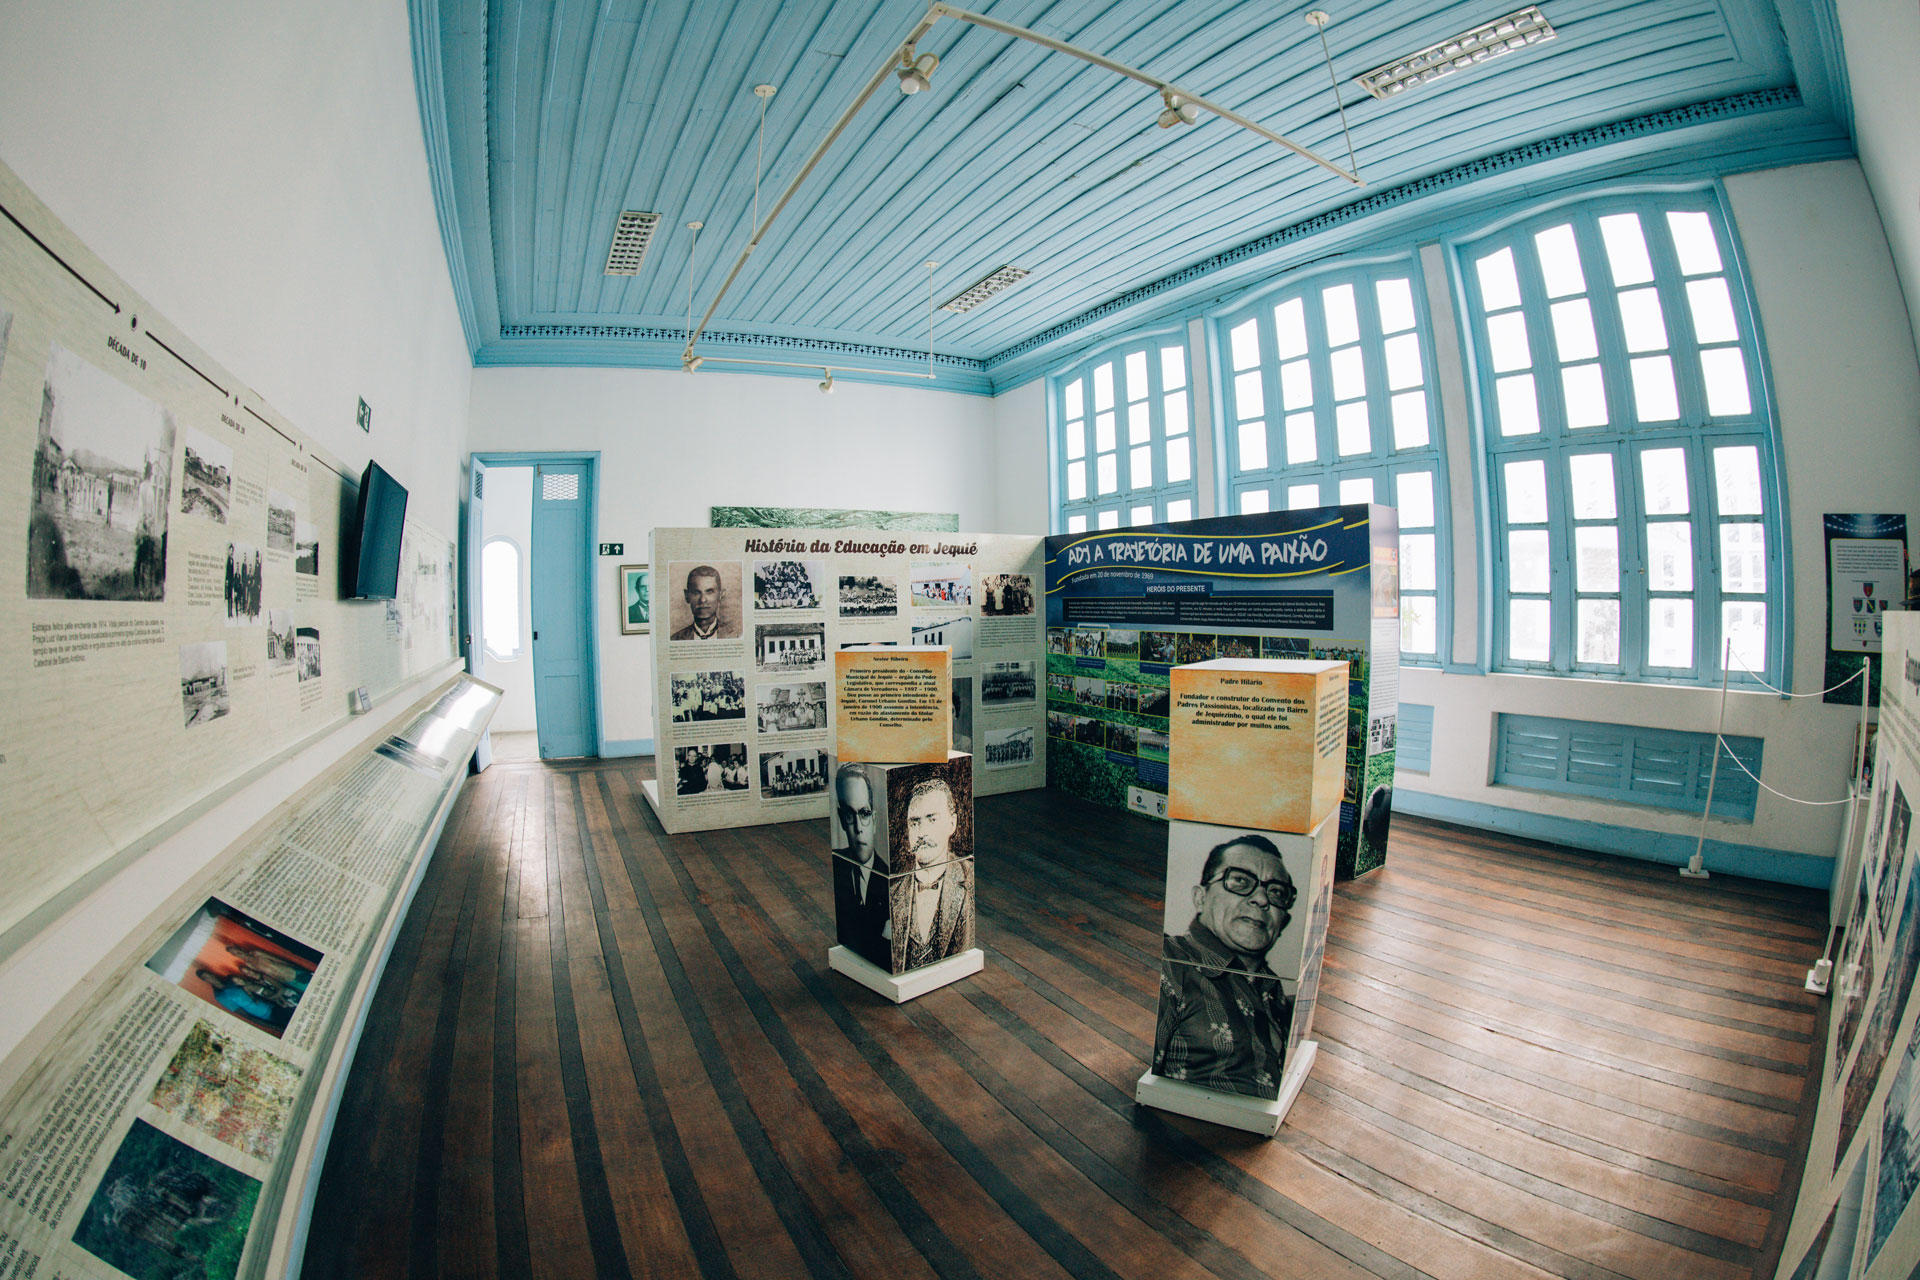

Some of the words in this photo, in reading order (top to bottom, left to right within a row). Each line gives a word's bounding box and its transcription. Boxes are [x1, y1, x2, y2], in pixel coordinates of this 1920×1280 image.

[108, 336, 130, 360] DÉCADA
[131, 353, 139, 364] DE
[140, 358, 146, 370] 10
[236, 423, 241, 432] DE
[745, 539, 807, 553] História
[810, 540, 831, 553] da
[835, 540, 906, 557] Educação
[910, 543, 930, 554] em
[933, 542, 978, 557] Jequié
[1068, 547, 1091, 565] ADJ
[1094, 544, 1104, 562] A
[1108, 538, 1187, 565] TRAJETÓRIA
[1194, 542, 1213, 565] DE
[1219, 542, 1255, 564] UMA
[1261, 534, 1328, 565] PAIXÃO
[1072, 573, 1089, 584] Fundada
[1110, 571, 1133, 579] novembro
[1141, 572, 1153, 580] 1969
[1147, 584, 1166, 593] HERÓIS
[1200, 702, 1240, 711] Passionistas,
[1205, 711, 1244, 720] Jequiezinho,
[6, 1158, 21, 1182] entanto,
[28, 1127, 42, 1148] indícios
[42, 1114, 51, 1126] mais
[52, 1094, 65, 1113] antigos
[64, 1086, 71, 1095] de
[18, 1198, 25, 1207] se
[24, 1170, 42, 1197] encontra
[44, 1144, 56, 1162] Pedra
[56, 1135, 63, 1144] da
[75, 1085, 95, 1116] Monumento
[46, 1164, 59, 1183] Dizem
[62, 1124, 84, 1157] historiadores
[8, 1176, 24, 1199] Manoel
[22, 1154, 38, 1177] Vitorino,
[39, 1208, 49, 1221] que
[45, 1188, 60, 1209] viviam
[57, 1179, 64, 1188] na
[77, 1124, 96, 1154] Localizada
[49, 1219, 56, 1228] de
[53, 1191, 72, 1219] conhecer
[69, 1180, 77, 1192] um
[74, 1154, 92, 1181] ambiente
[89, 1126, 108, 1154] doméstico
[7, 1239, 19, 1256] pela
[24, 1255, 40, 1279] depois
